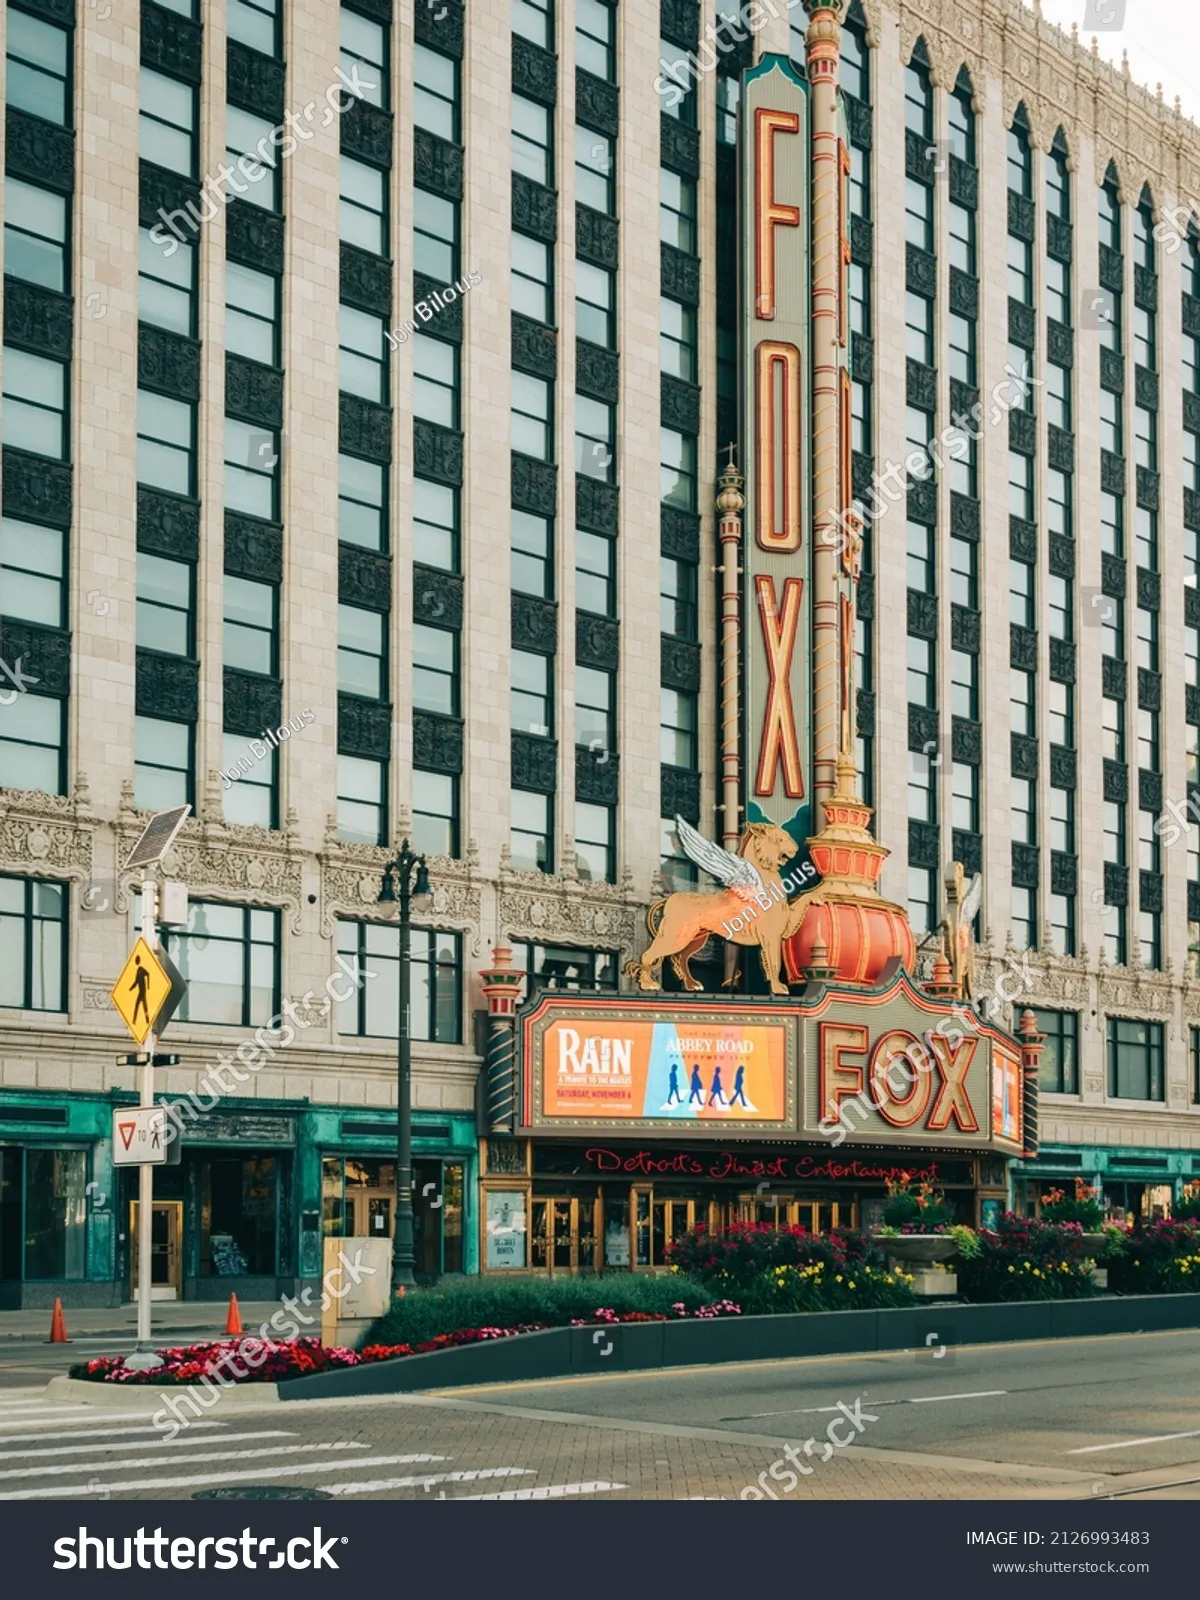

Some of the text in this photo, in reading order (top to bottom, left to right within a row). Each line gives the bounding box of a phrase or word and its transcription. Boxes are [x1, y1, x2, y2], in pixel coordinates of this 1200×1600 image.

[753, 107, 805, 799] FOX
[556, 1028, 632, 1075] RAIN
[666, 1038, 754, 1054] ABBEY ROAD
[556, 1089, 591, 1100] SATURDAY,
[592, 1090, 626, 1100] NOVEMBER
[818, 1021, 979, 1132] FOX
[585, 1148, 703, 1175] Detroit's
[709, 1152, 789, 1178] Finest
